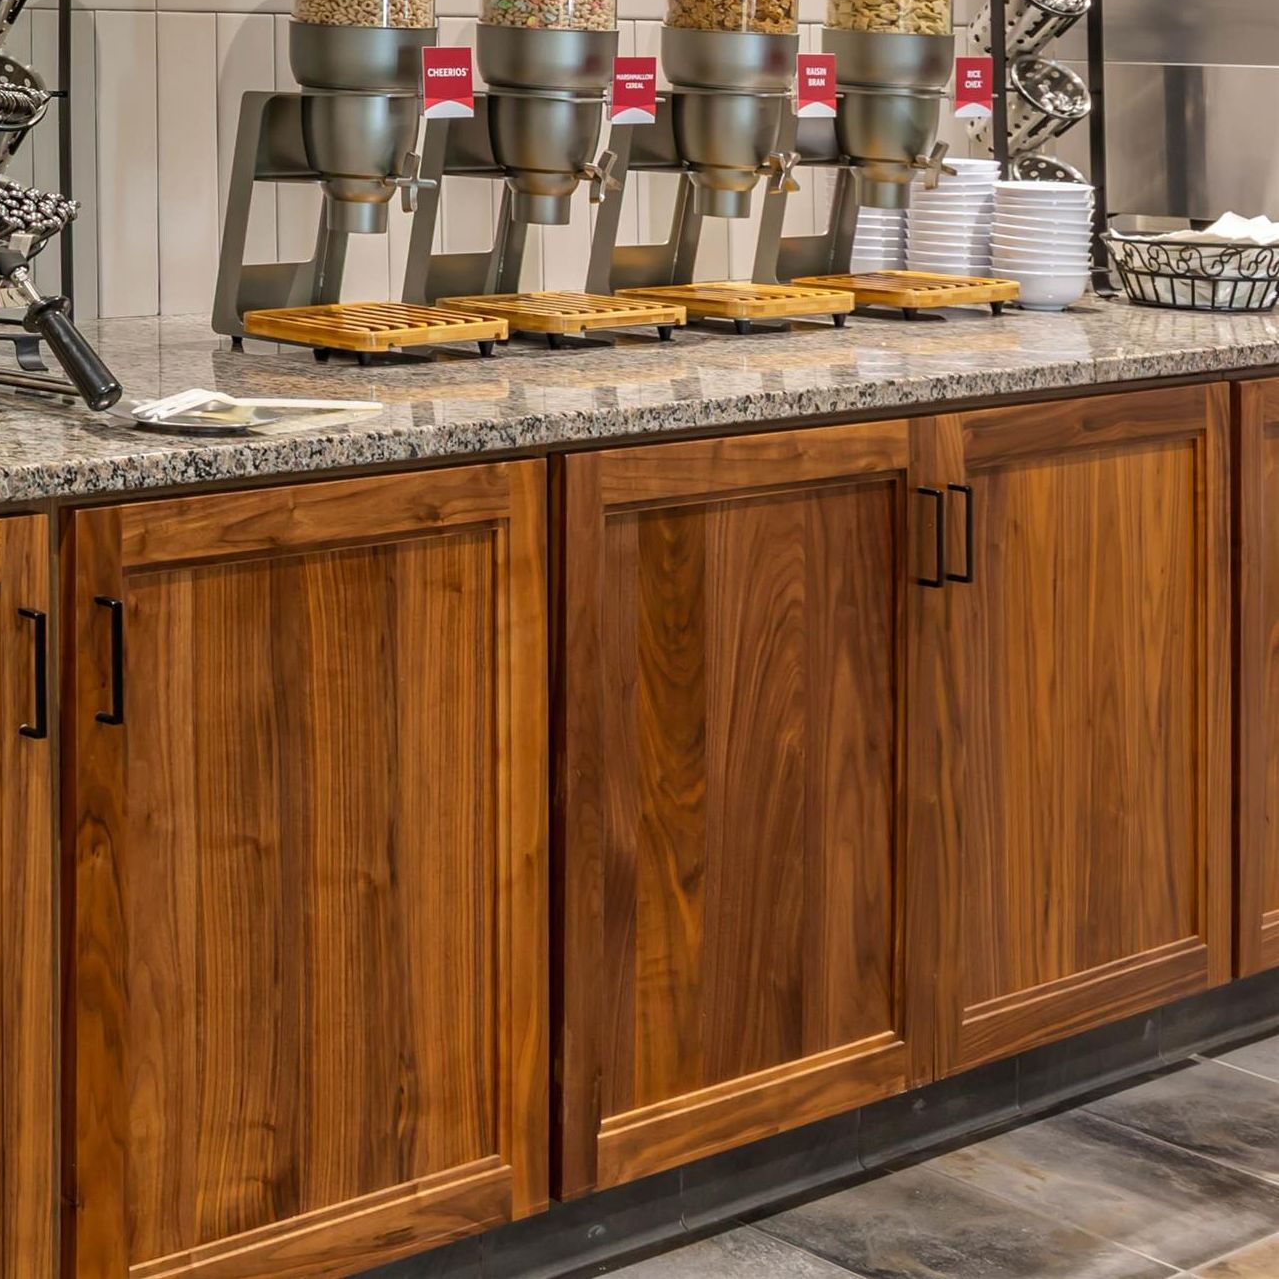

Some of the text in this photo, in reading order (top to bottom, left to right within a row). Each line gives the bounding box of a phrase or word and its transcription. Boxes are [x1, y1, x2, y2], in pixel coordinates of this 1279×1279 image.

[427, 67, 467, 77] CHEERIOS
[805, 67, 827, 76] RAISIN
[966, 70, 982, 79] RICE
[808, 78, 826, 87] BRAN
